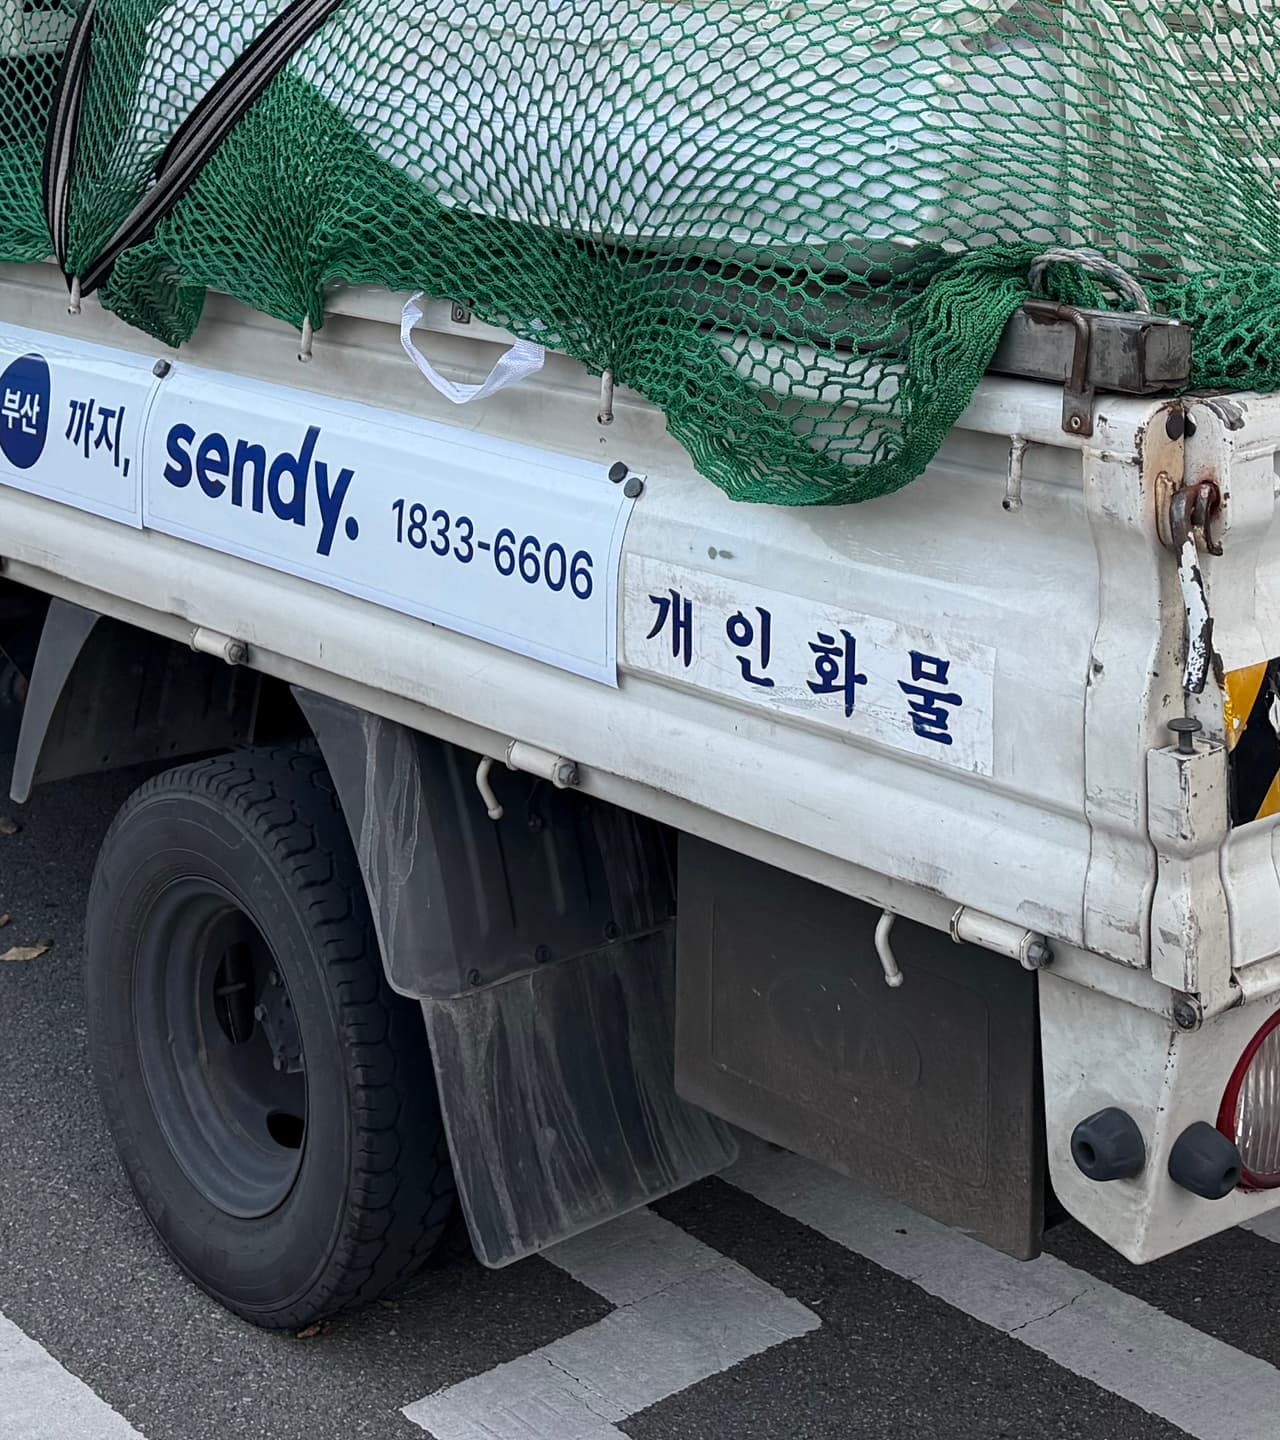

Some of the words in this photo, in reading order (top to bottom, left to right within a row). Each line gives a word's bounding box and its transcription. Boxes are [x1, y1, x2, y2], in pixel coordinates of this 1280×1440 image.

[1, 388, 41, 435] 부산
[66, 397, 131, 477] 까지,
[163, 423, 359, 557] sendy.
[391, 498, 594, 600] 1833-6606
[646, 588, 963, 746] 개인화물
